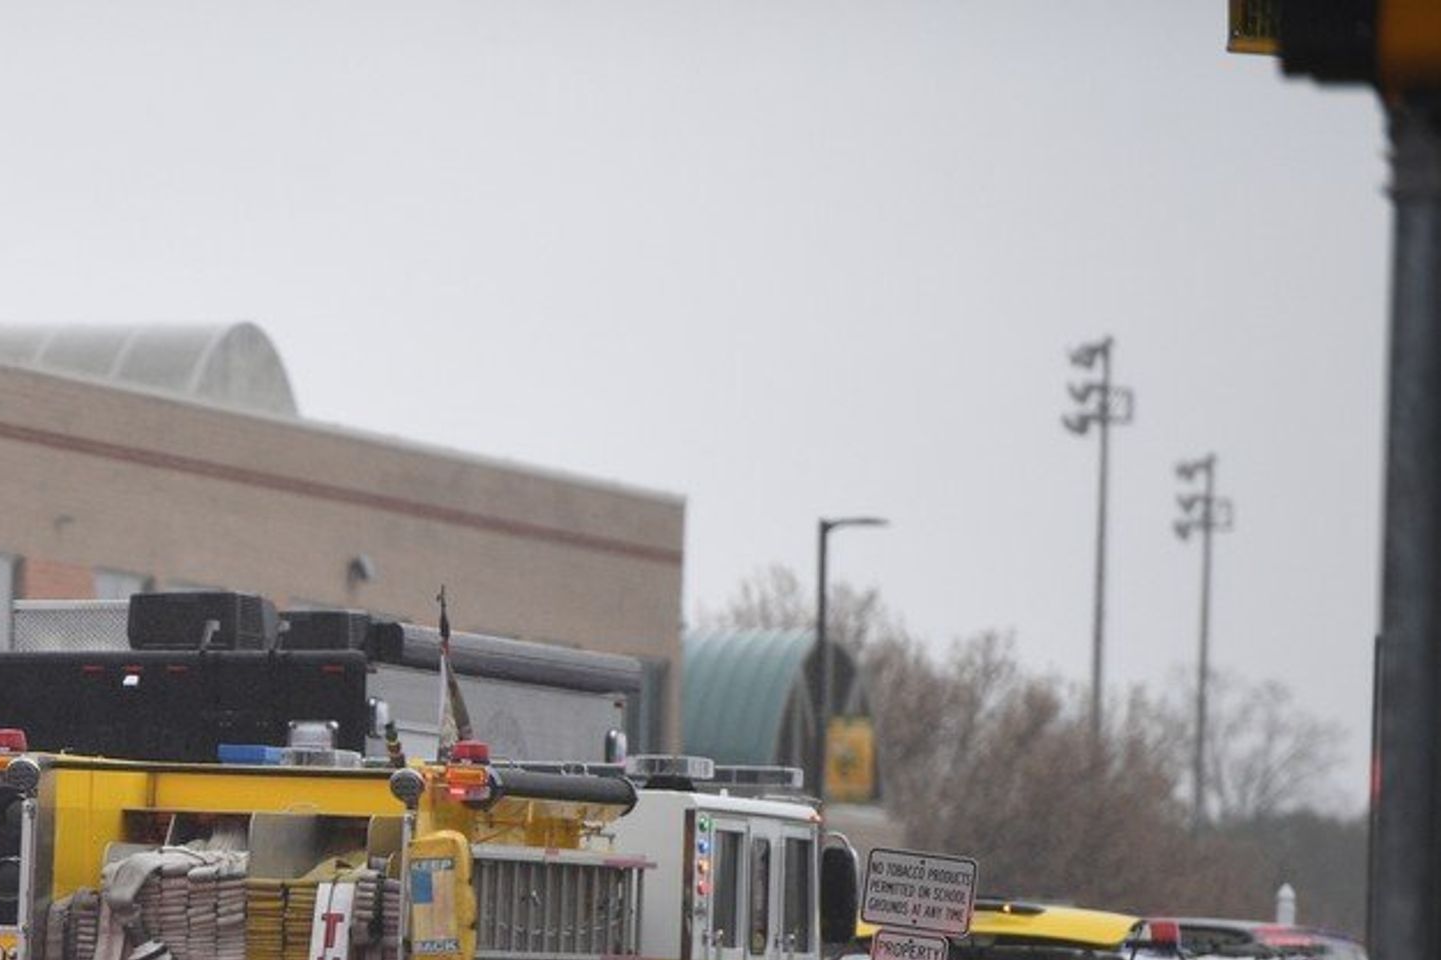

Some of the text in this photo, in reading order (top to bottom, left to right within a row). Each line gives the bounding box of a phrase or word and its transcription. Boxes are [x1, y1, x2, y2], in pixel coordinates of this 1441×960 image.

[872, 861, 972, 887] NO TOBACCO PRODUCTS
[869, 881, 966, 905] PERMITTED ON SCHOOL
[868, 898, 963, 923] GROUNDS AT ANY TIME
